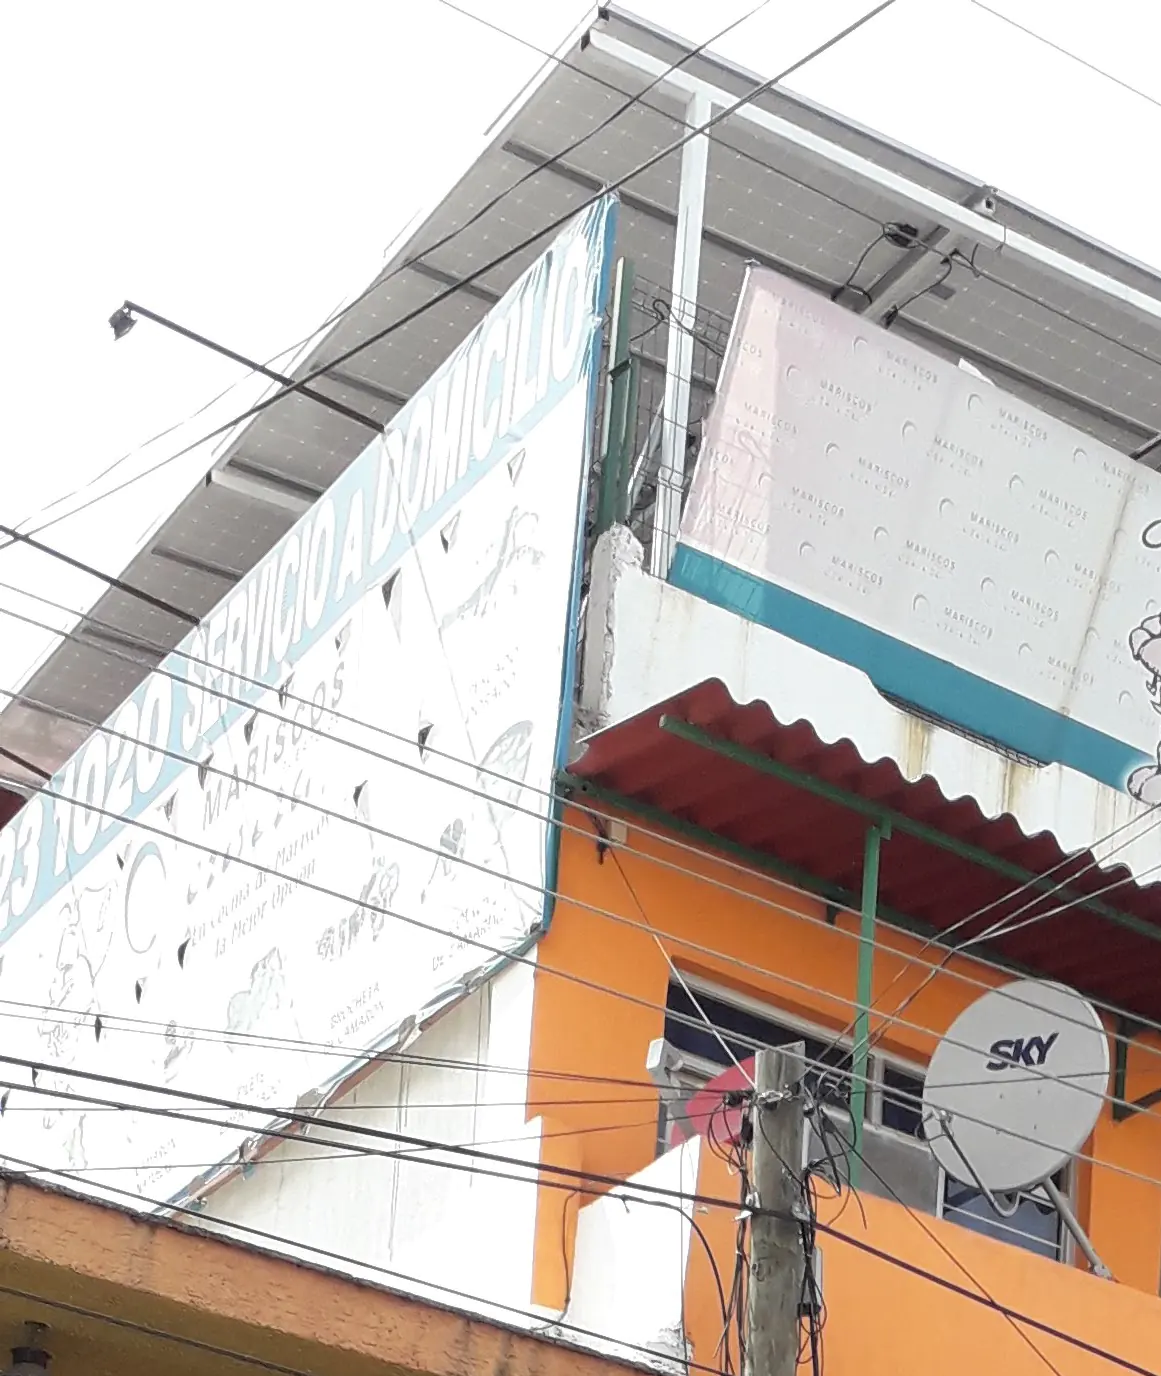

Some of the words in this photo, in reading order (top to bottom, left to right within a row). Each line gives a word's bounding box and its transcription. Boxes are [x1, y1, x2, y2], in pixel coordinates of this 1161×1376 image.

[52, 671, 173, 877] 1020
[180, 497, 336, 752] SERVICIO
[335, 486, 366, 603] A
[367, 231, 588, 568] DOMICILIO
[985, 1032, 1060, 1072] SKY
